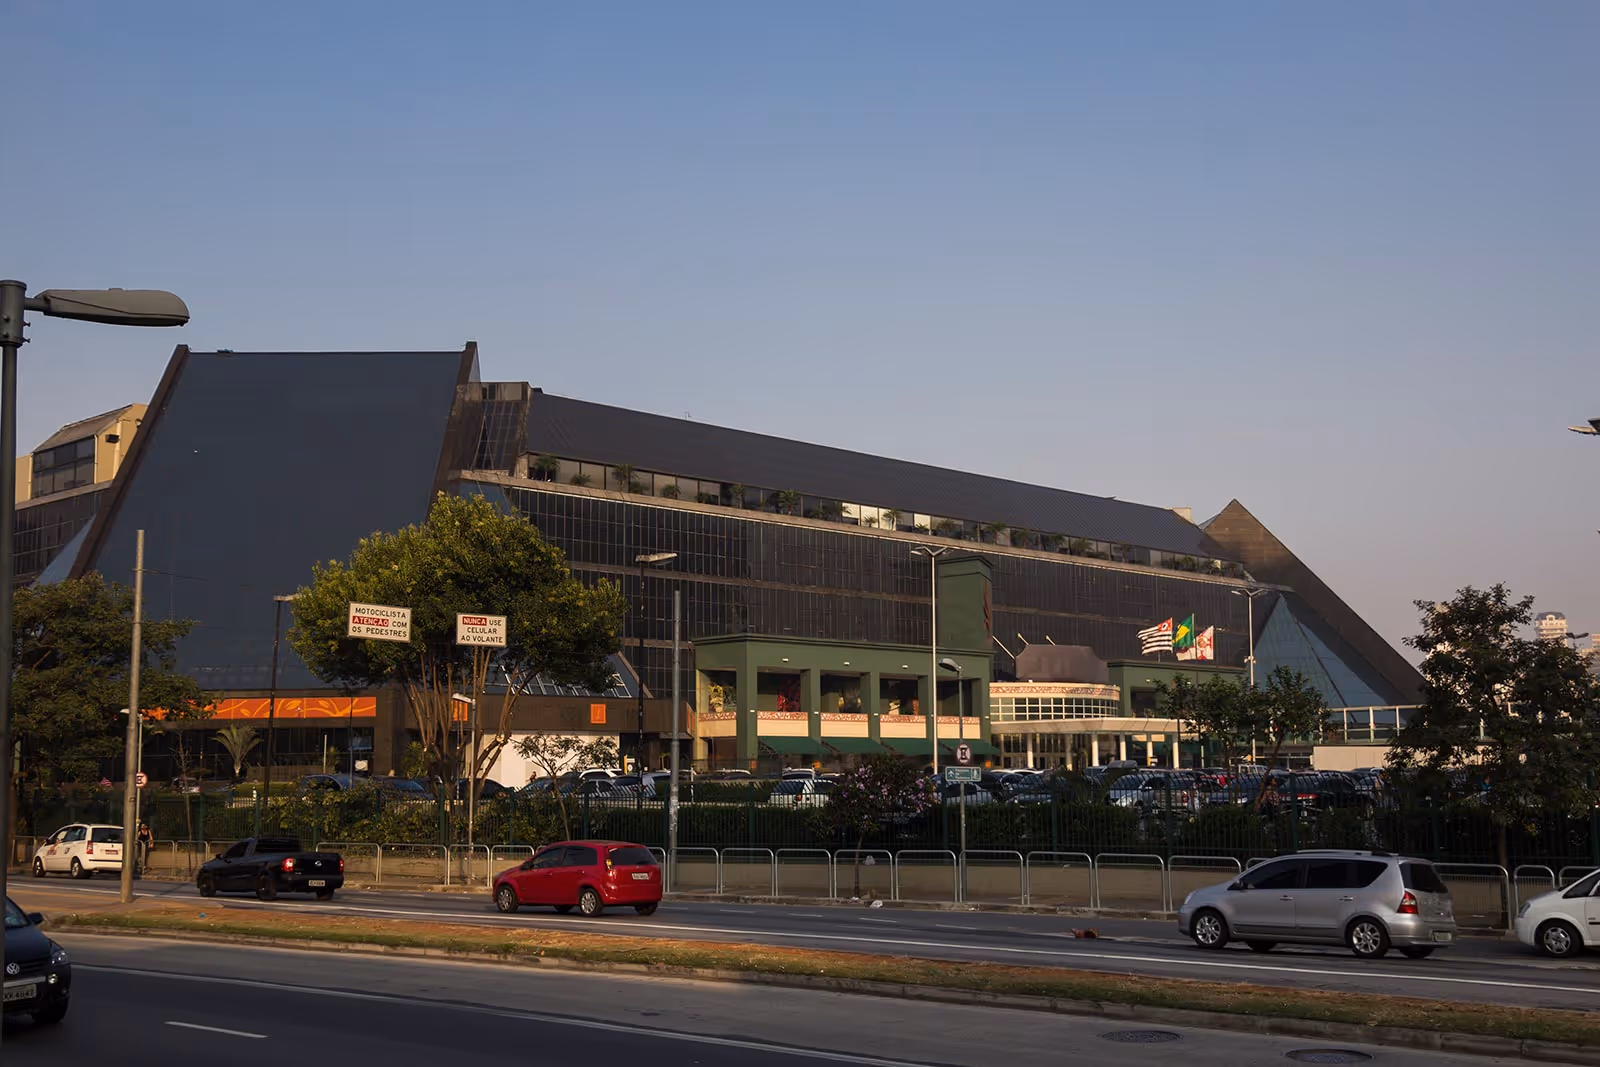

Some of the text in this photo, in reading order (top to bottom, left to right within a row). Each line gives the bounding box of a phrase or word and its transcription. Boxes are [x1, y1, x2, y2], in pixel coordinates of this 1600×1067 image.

[355, 607, 406, 618] MOTOCICLISTA
[463, 617, 487, 625] NUNCA
[366, 627, 407, 638] PEDESTRES
[467, 627, 498, 635] CELULAR
[472, 635, 503, 643] VOLANTE
